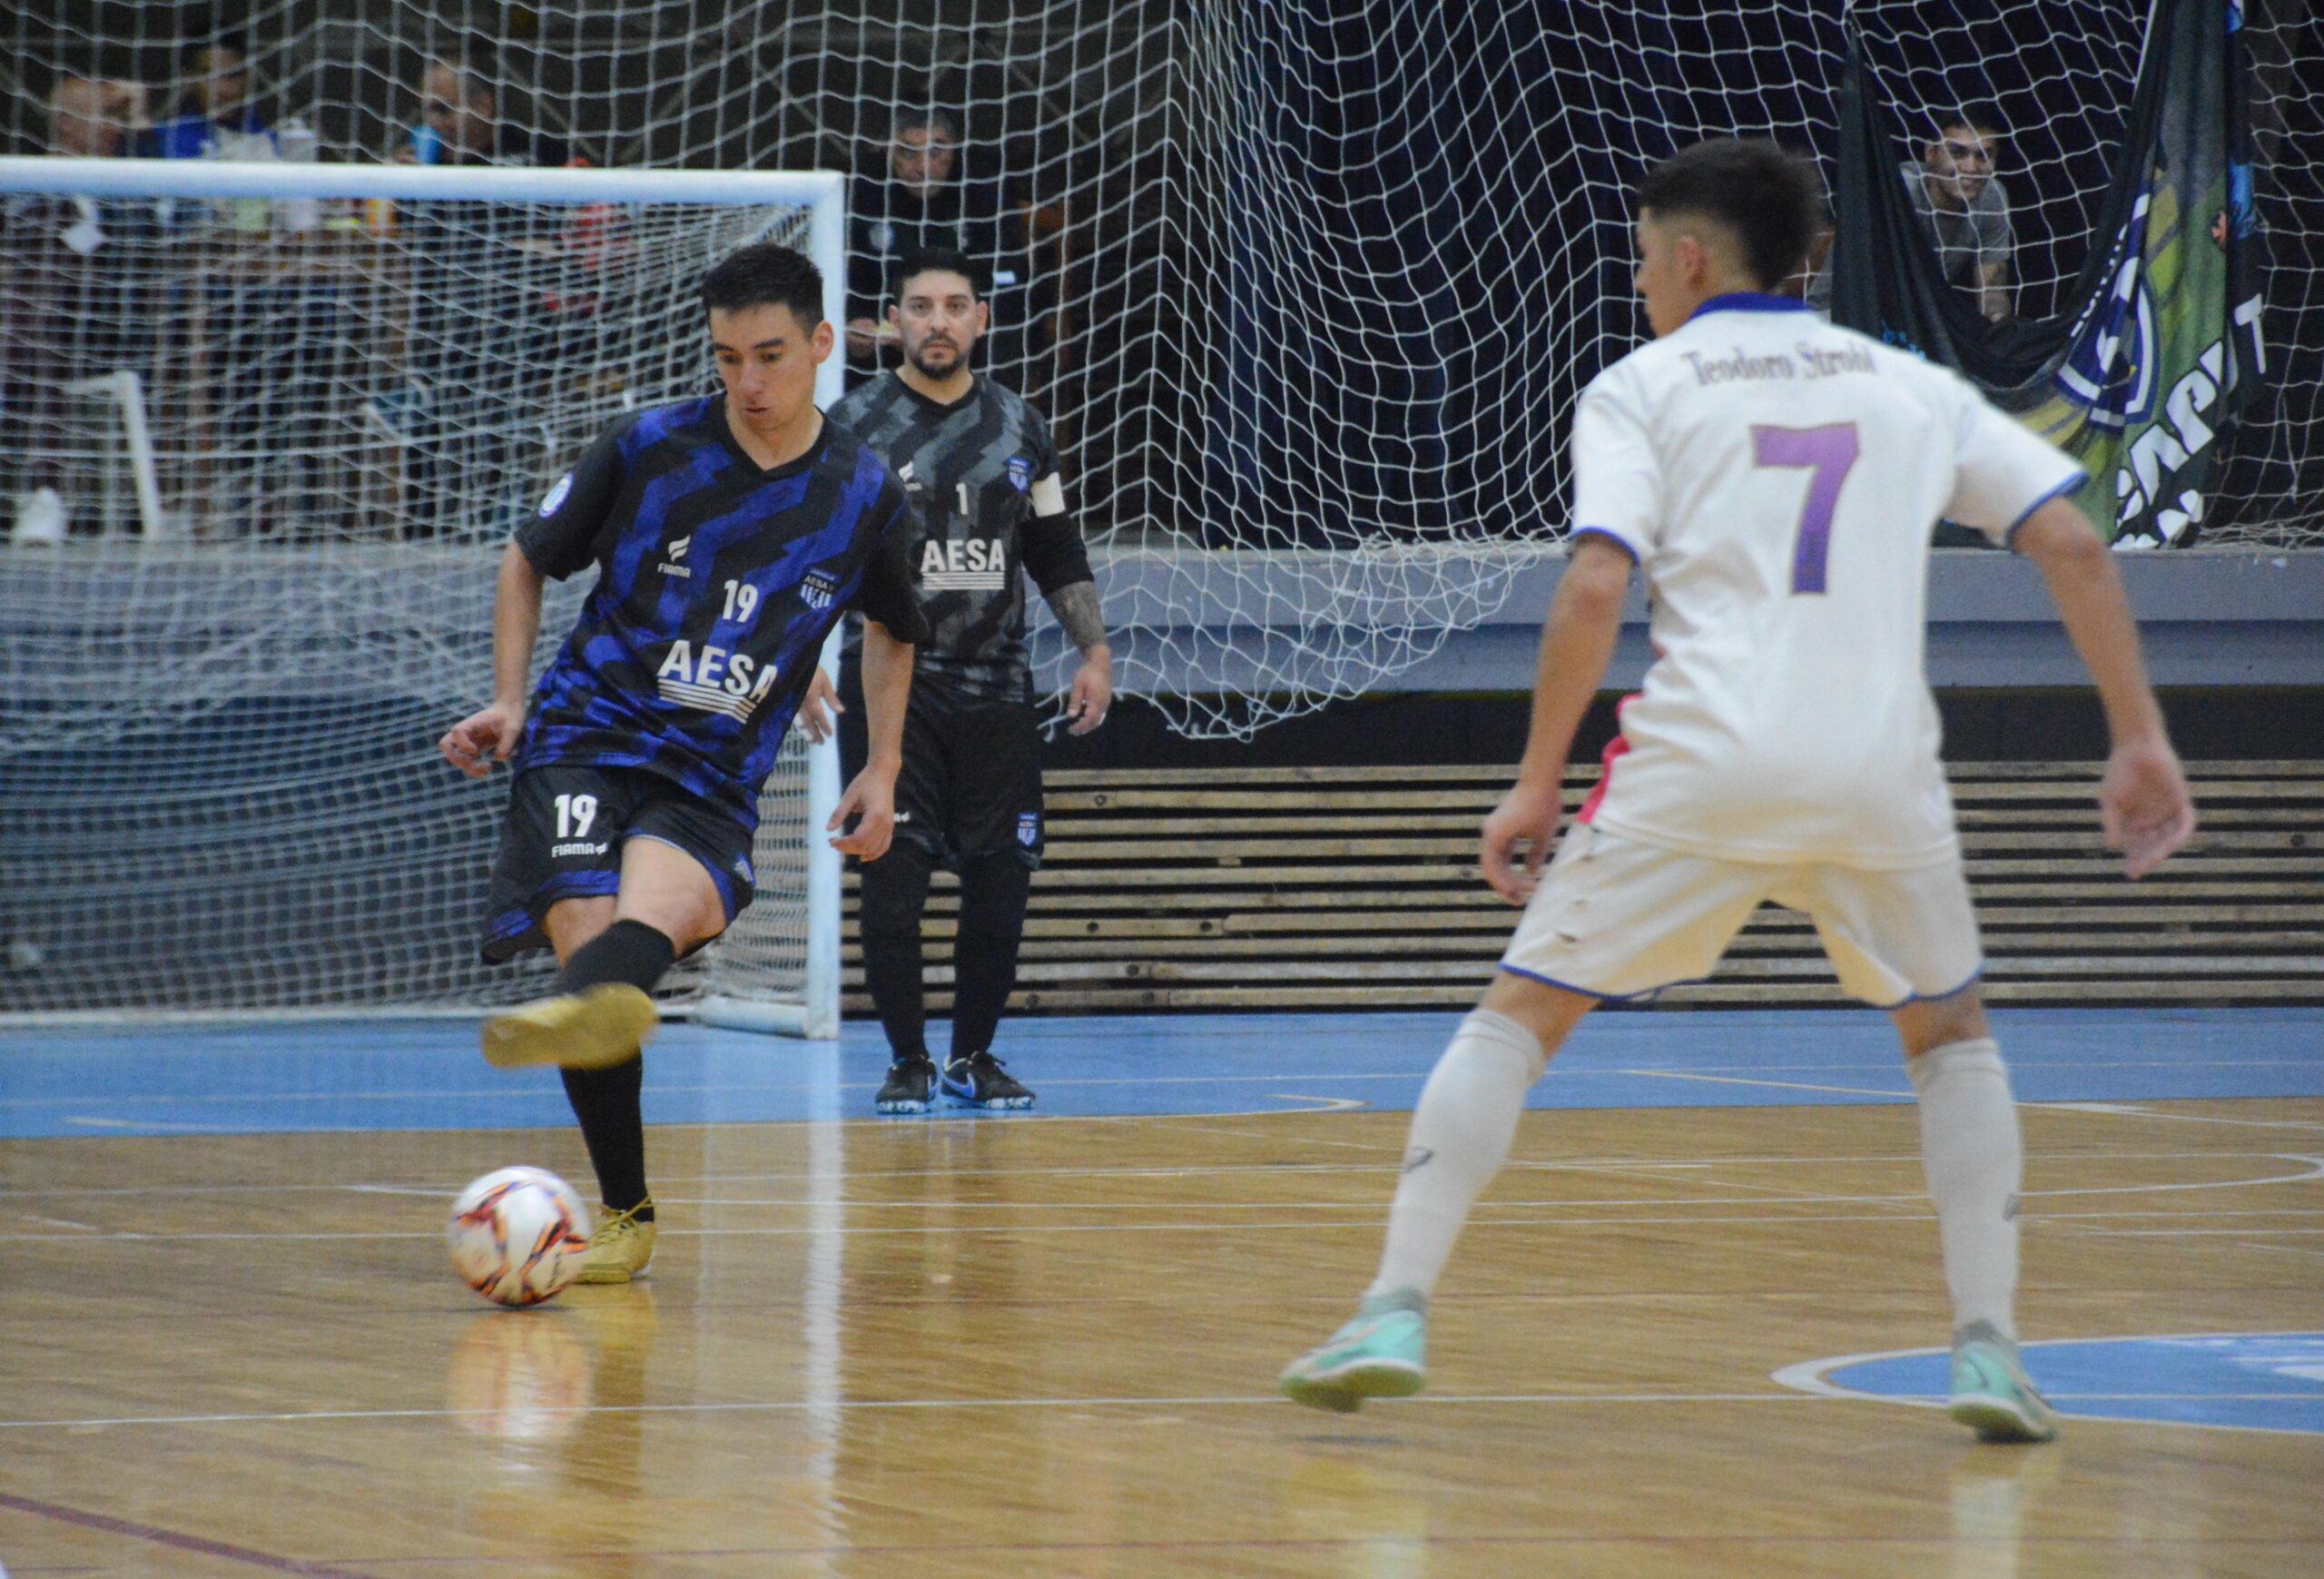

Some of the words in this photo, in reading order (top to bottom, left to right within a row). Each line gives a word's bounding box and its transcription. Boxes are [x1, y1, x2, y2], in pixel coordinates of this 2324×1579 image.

[956, 482, 969, 515] 1
[1750, 420, 1861, 595] 7
[921, 538, 1006, 571] AESA
[723, 579, 759, 623] 19
[658, 639, 779, 703] AESA
[554, 794, 598, 838] 19
[551, 843, 596, 858] FIAMA
